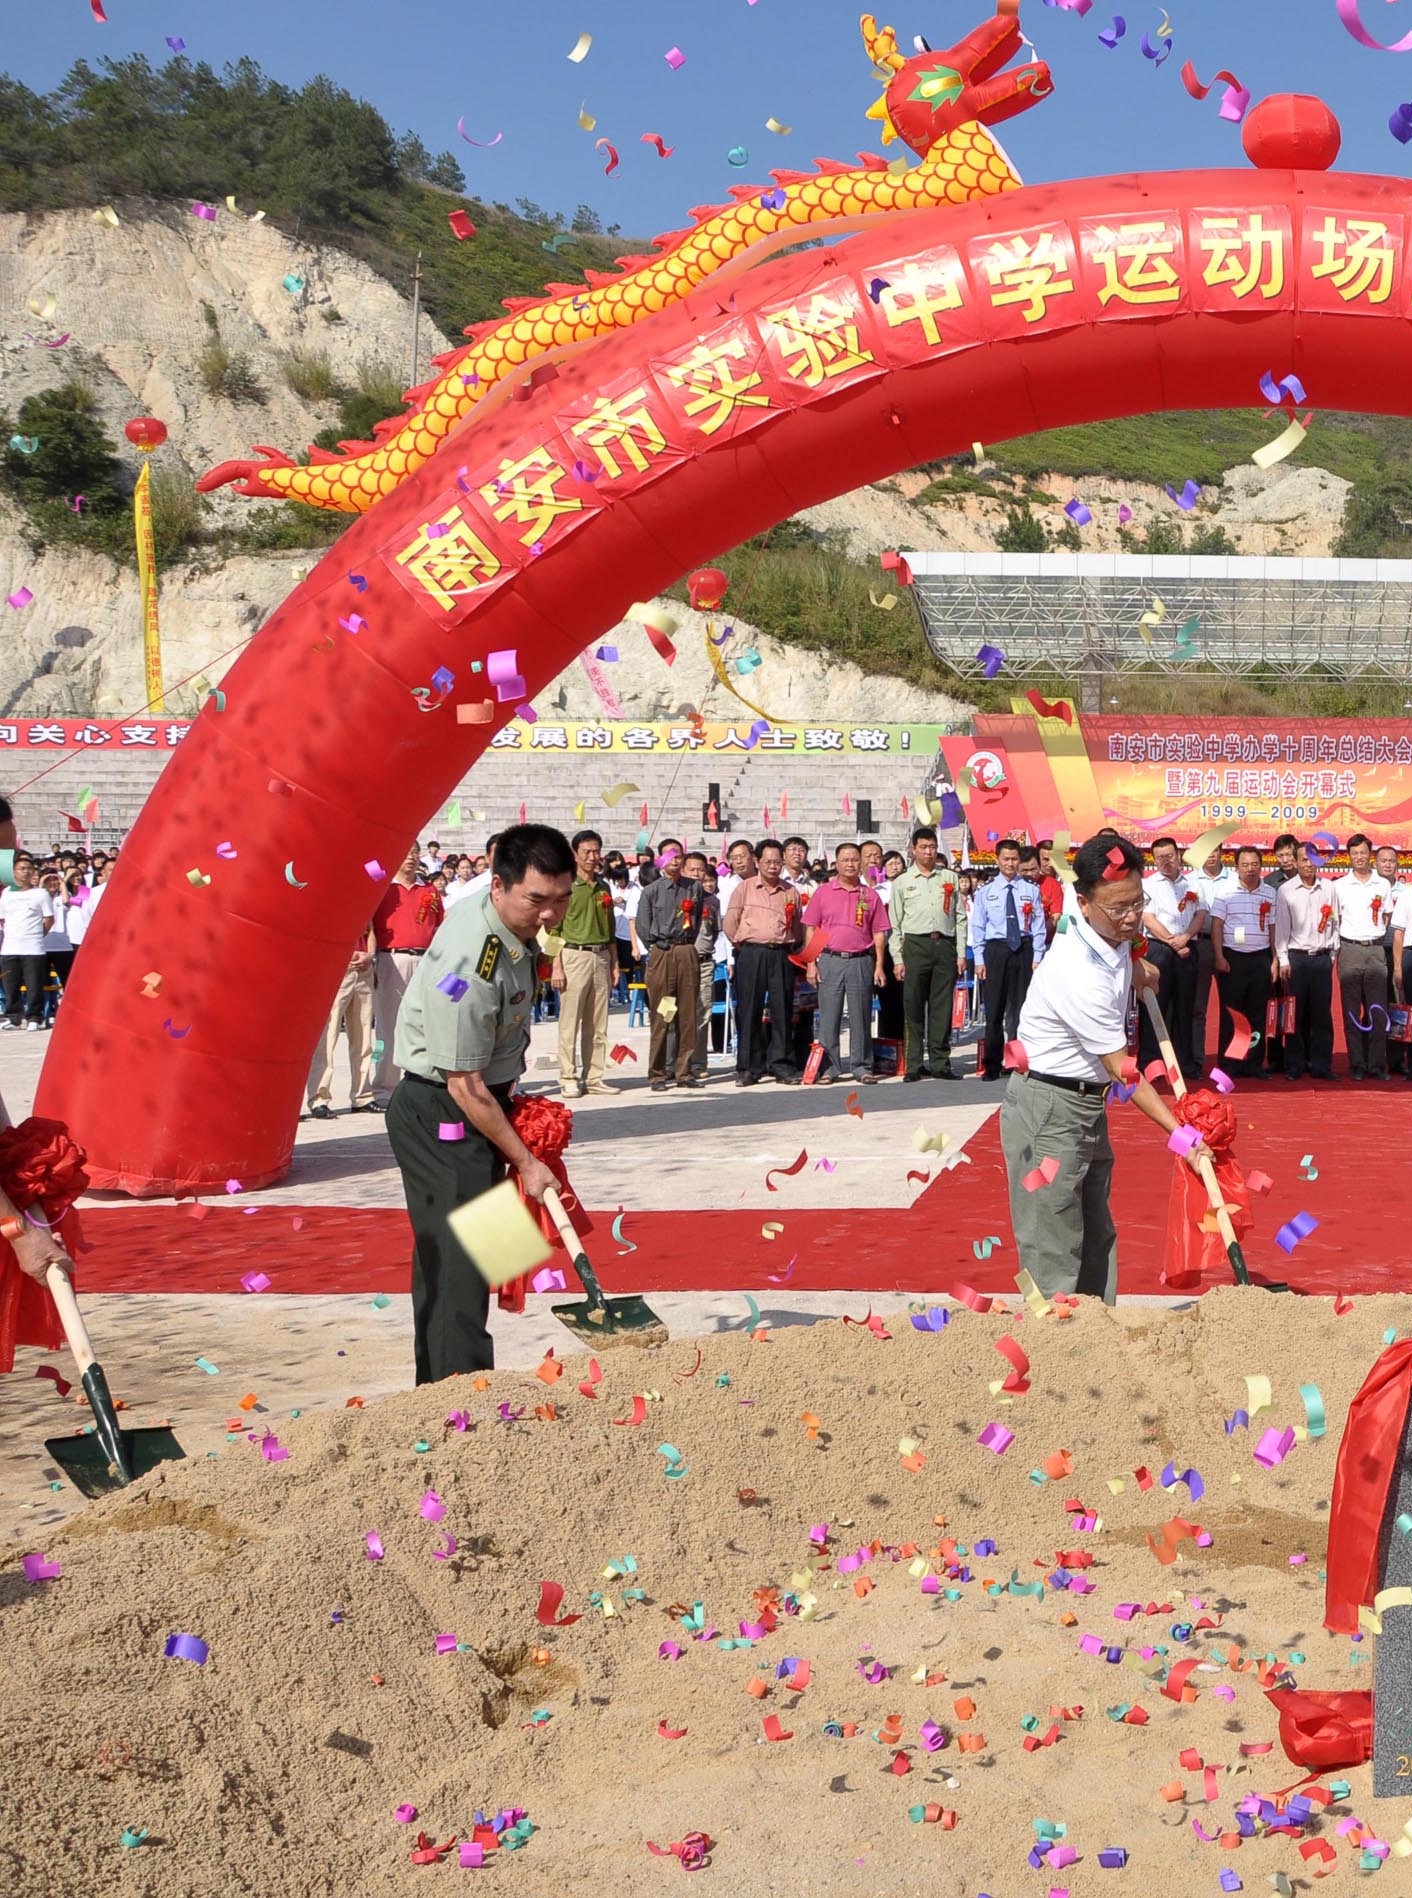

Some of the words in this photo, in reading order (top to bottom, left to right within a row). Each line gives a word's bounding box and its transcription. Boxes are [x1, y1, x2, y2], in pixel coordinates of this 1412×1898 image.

[1165, 769, 1358, 799] 暨第九届运动会开幕式
